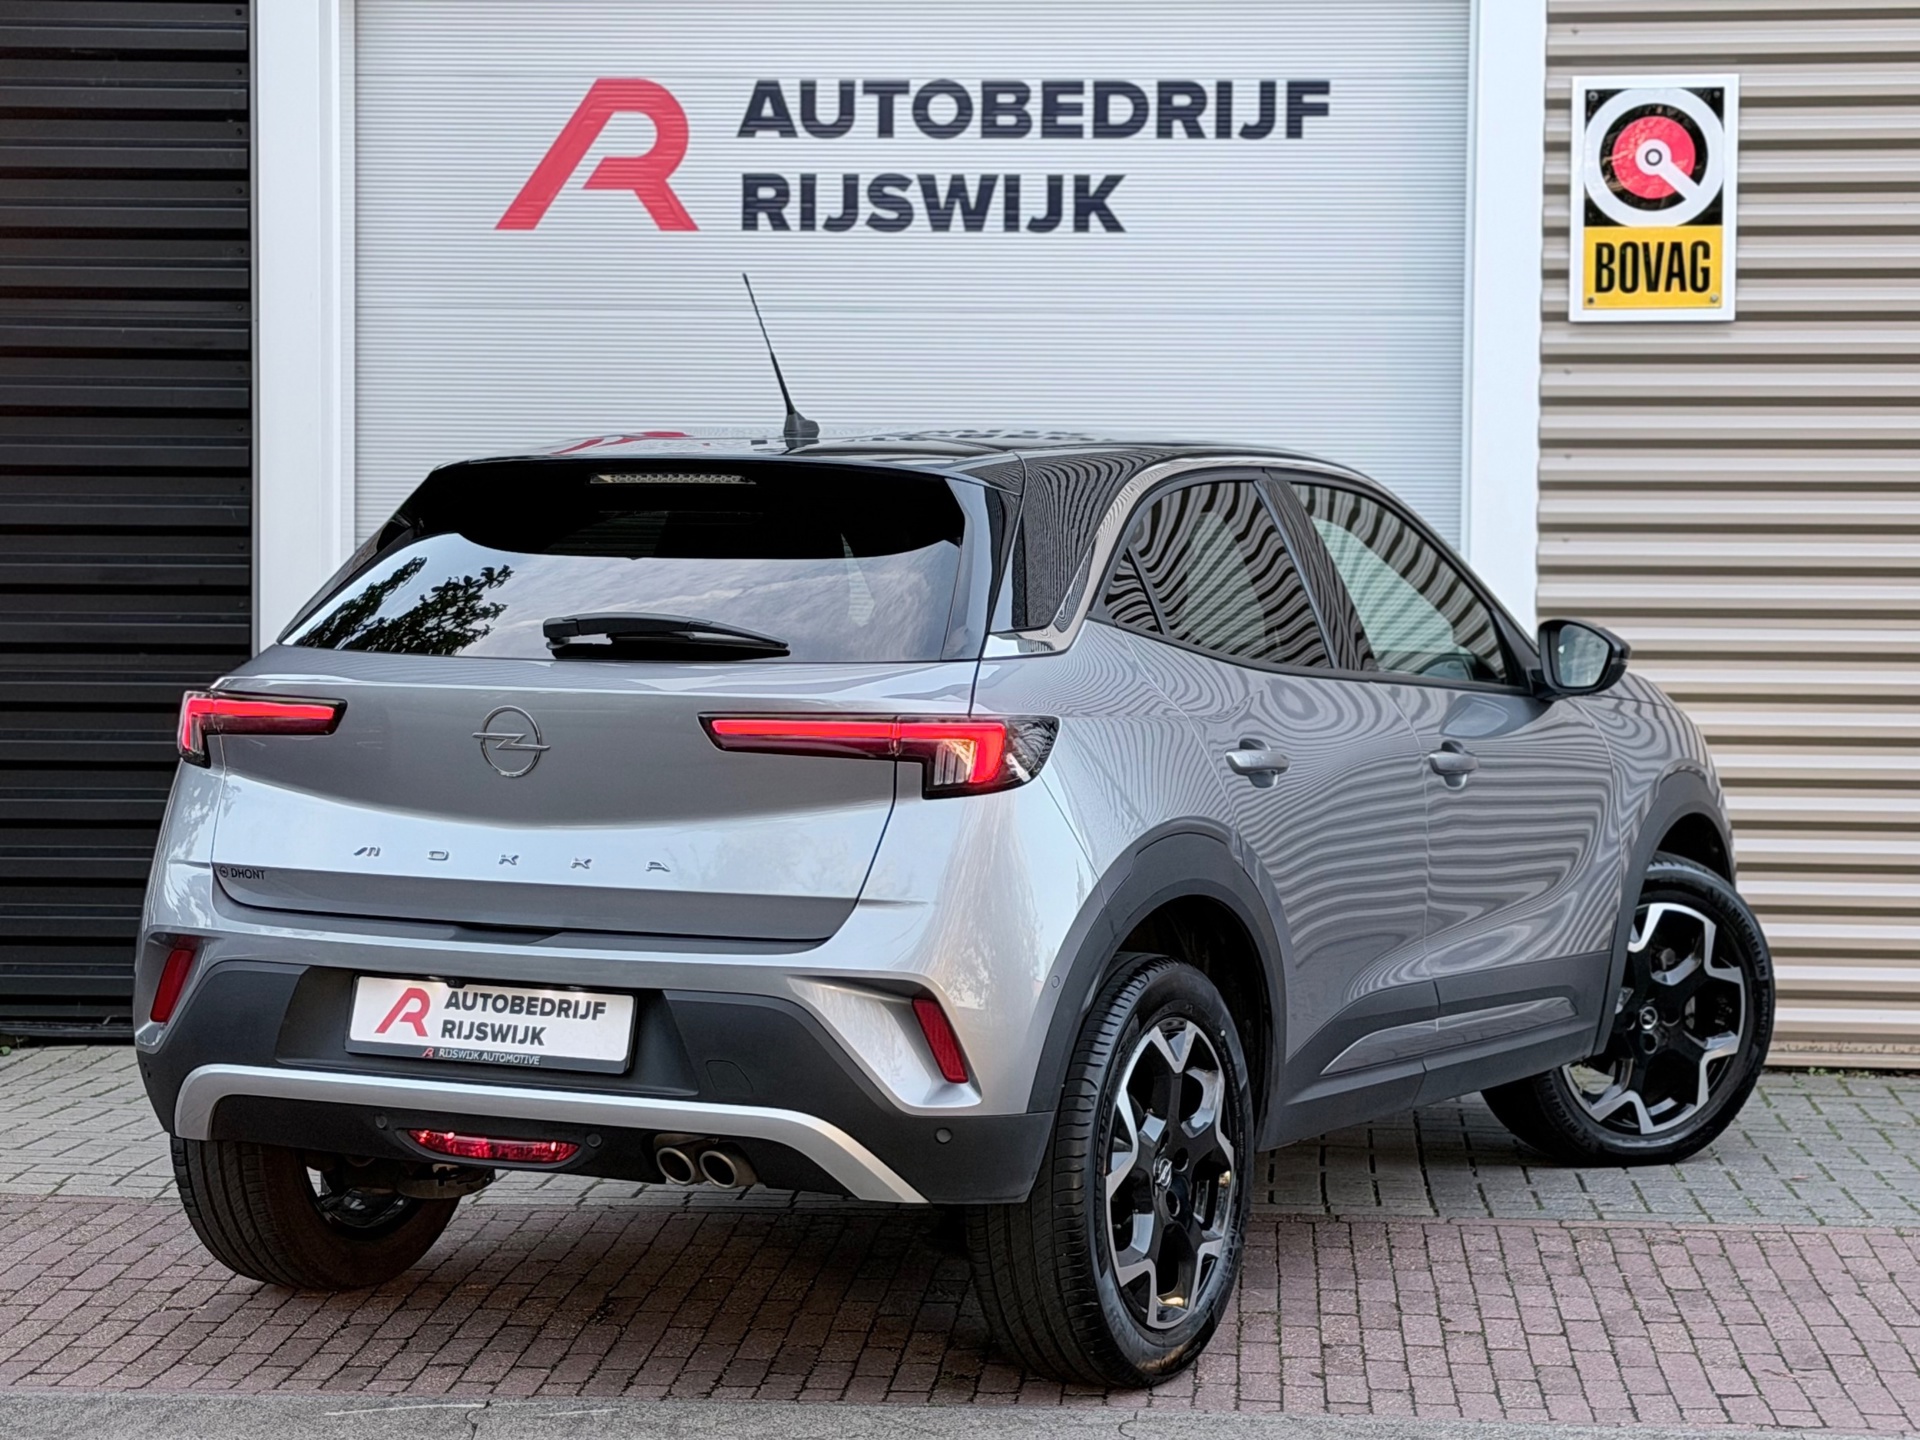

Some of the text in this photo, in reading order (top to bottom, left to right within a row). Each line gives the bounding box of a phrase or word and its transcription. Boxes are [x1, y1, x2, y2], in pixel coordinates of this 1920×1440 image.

[736, 79, 1331, 140] AUTOBEDRIJF
[740, 173, 1126, 233] RIJSWIJK
[1594, 240, 1711, 294] BOVAG
[230, 867, 266, 880] DHONT
[353, 845, 671, 873] MOKKA
[444, 990, 607, 1021] AUTOBEDRIJF
[440, 1019, 547, 1047] RIJSWIJK
[438, 1047, 541, 1065] RIJSWIJK AUTOMOTIVE
